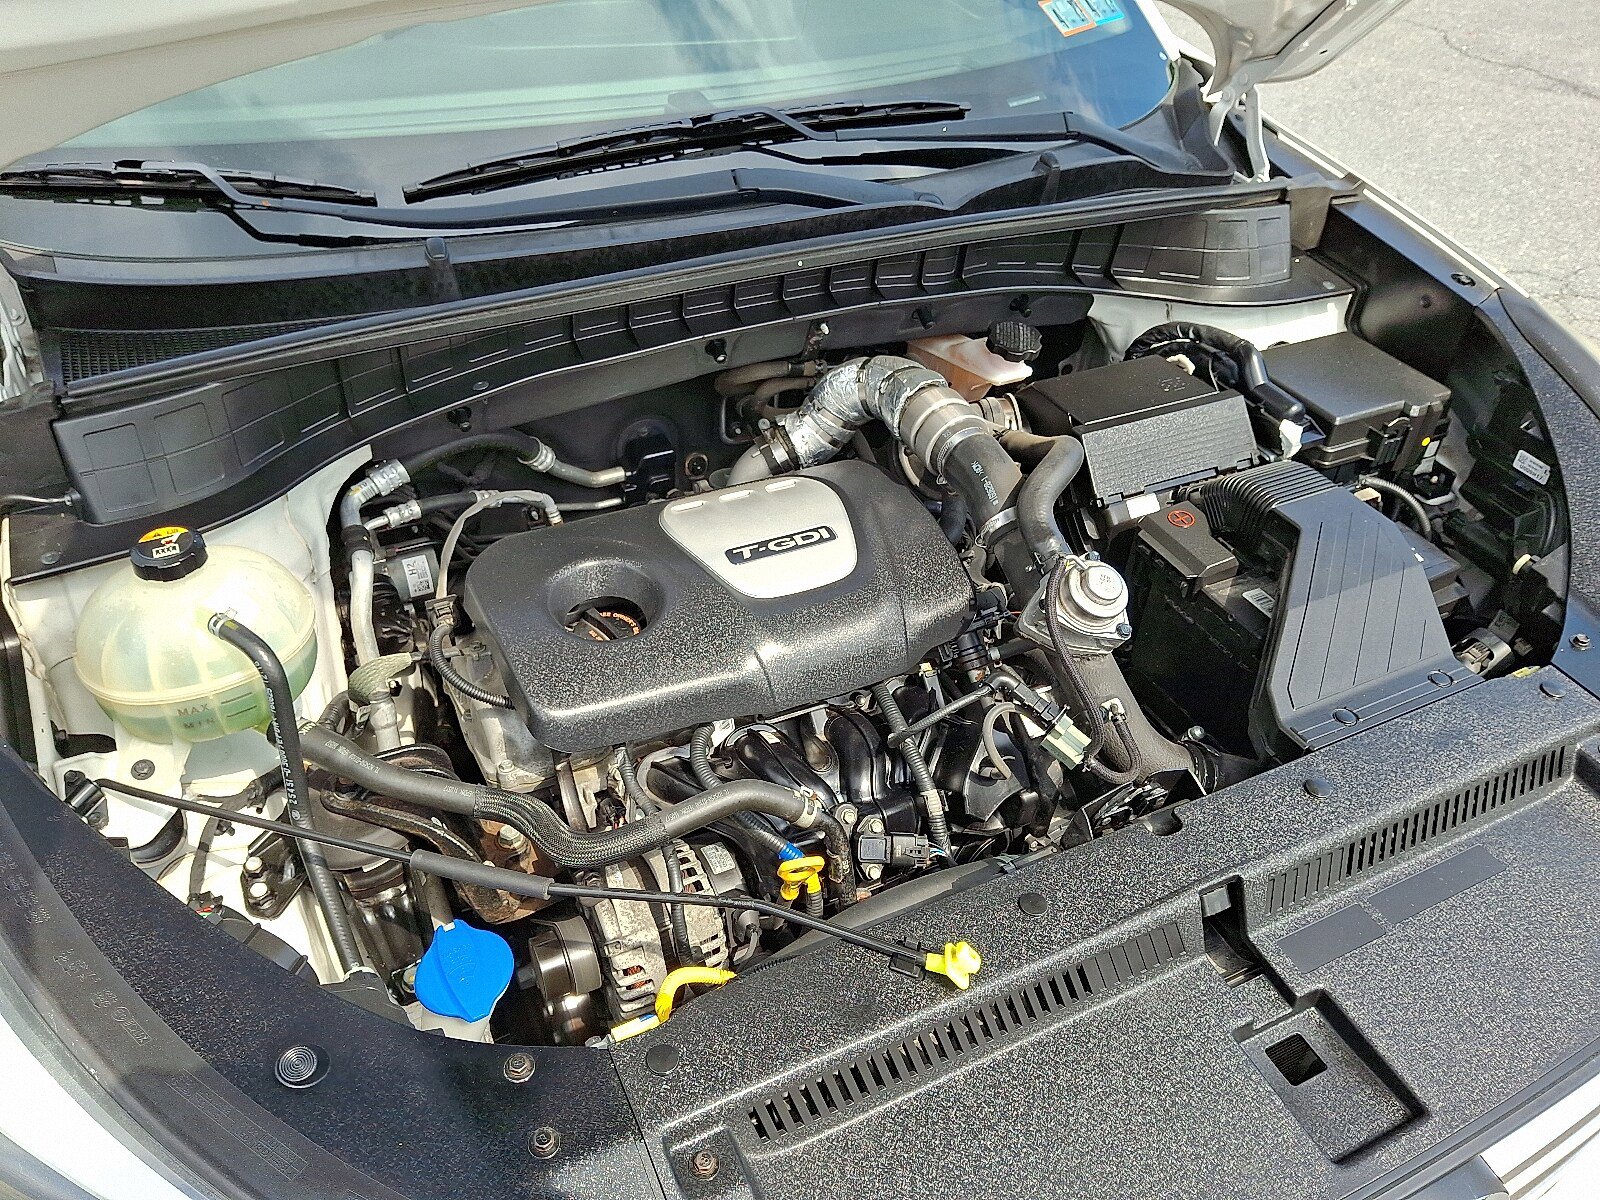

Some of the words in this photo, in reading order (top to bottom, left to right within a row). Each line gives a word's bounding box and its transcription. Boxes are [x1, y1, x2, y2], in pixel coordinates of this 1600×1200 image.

[732, 527, 831, 560] T-GDI
[177, 703, 210, 717] MAX
[183, 717, 216, 729] MIN
